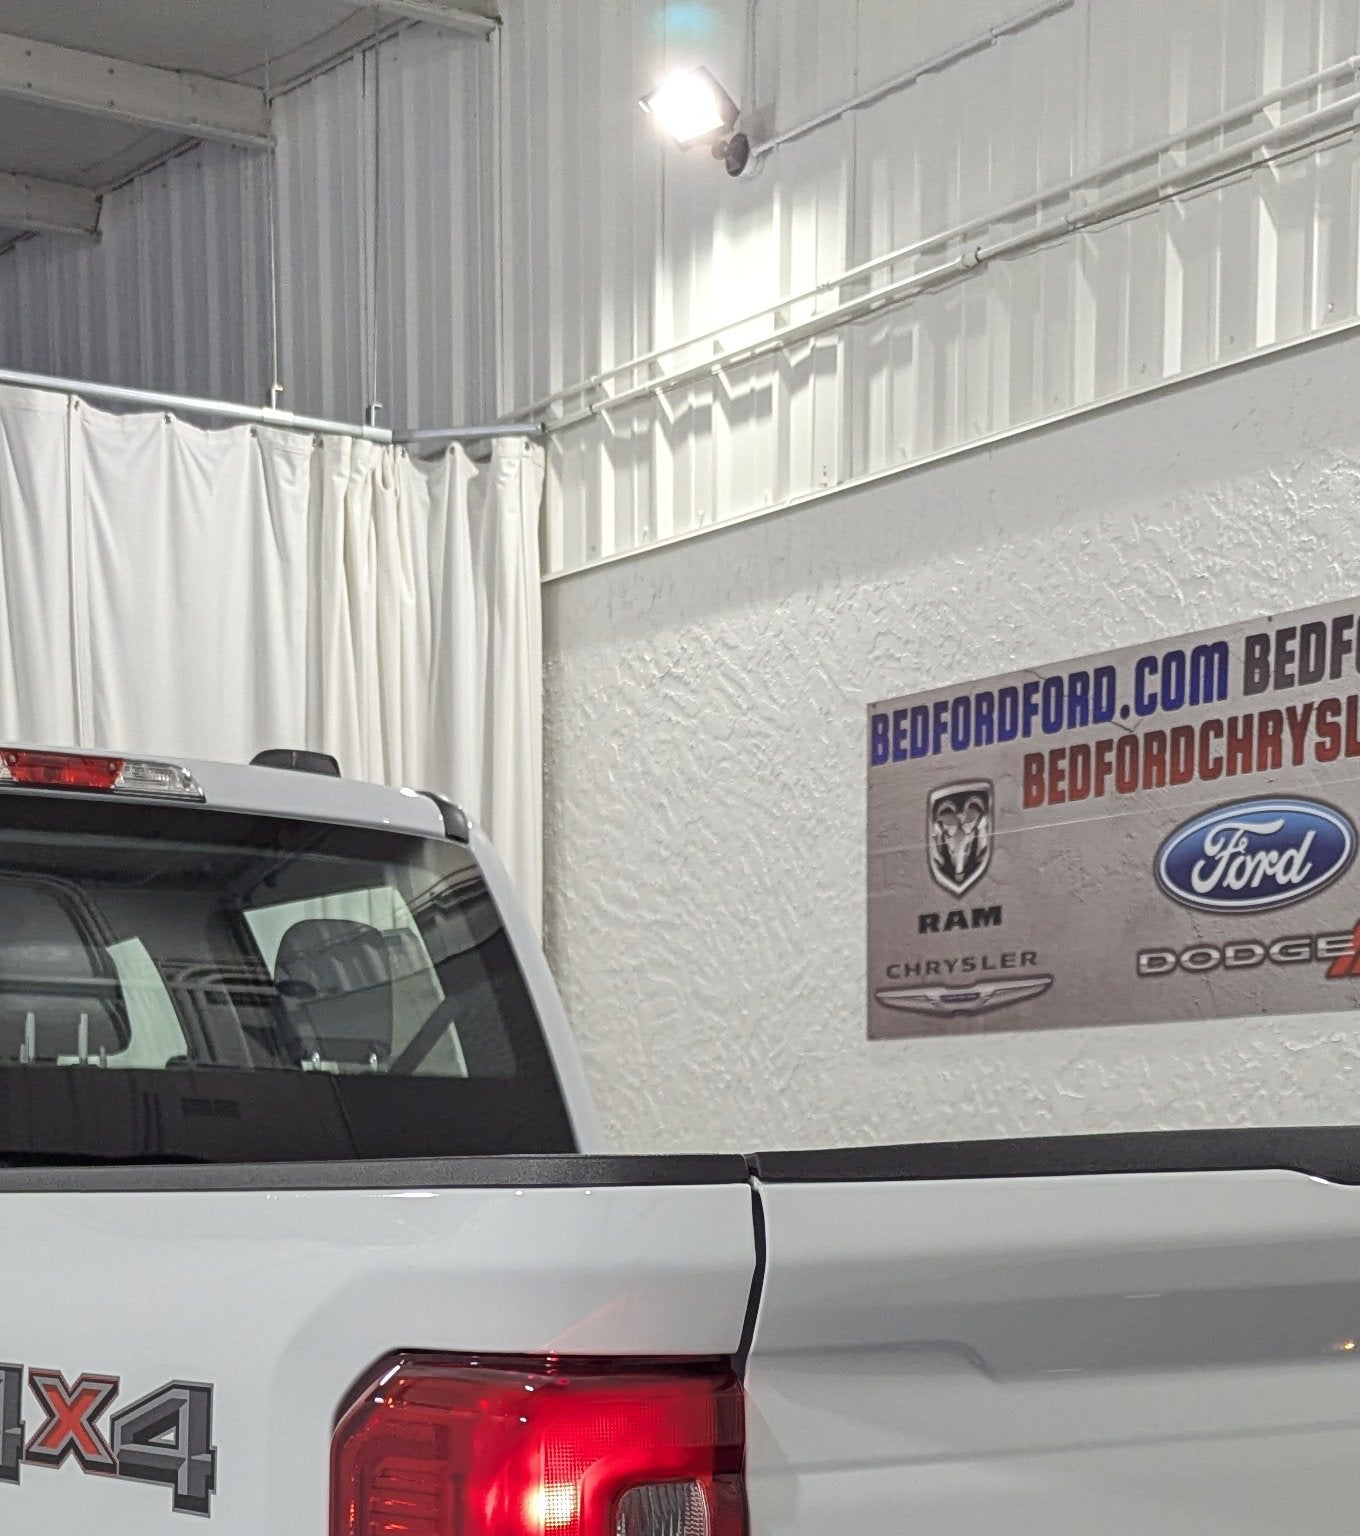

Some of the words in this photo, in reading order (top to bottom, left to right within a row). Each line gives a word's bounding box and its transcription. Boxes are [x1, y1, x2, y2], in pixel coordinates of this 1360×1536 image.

[871, 640, 1230, 767] BEDFORDFORD.COM
[1191, 818, 1317, 894] Ford
[918, 905, 1003, 935] RAM
[886, 951, 1038, 980] CHRYSLER
[1138, 930, 1356, 976] DODGE
